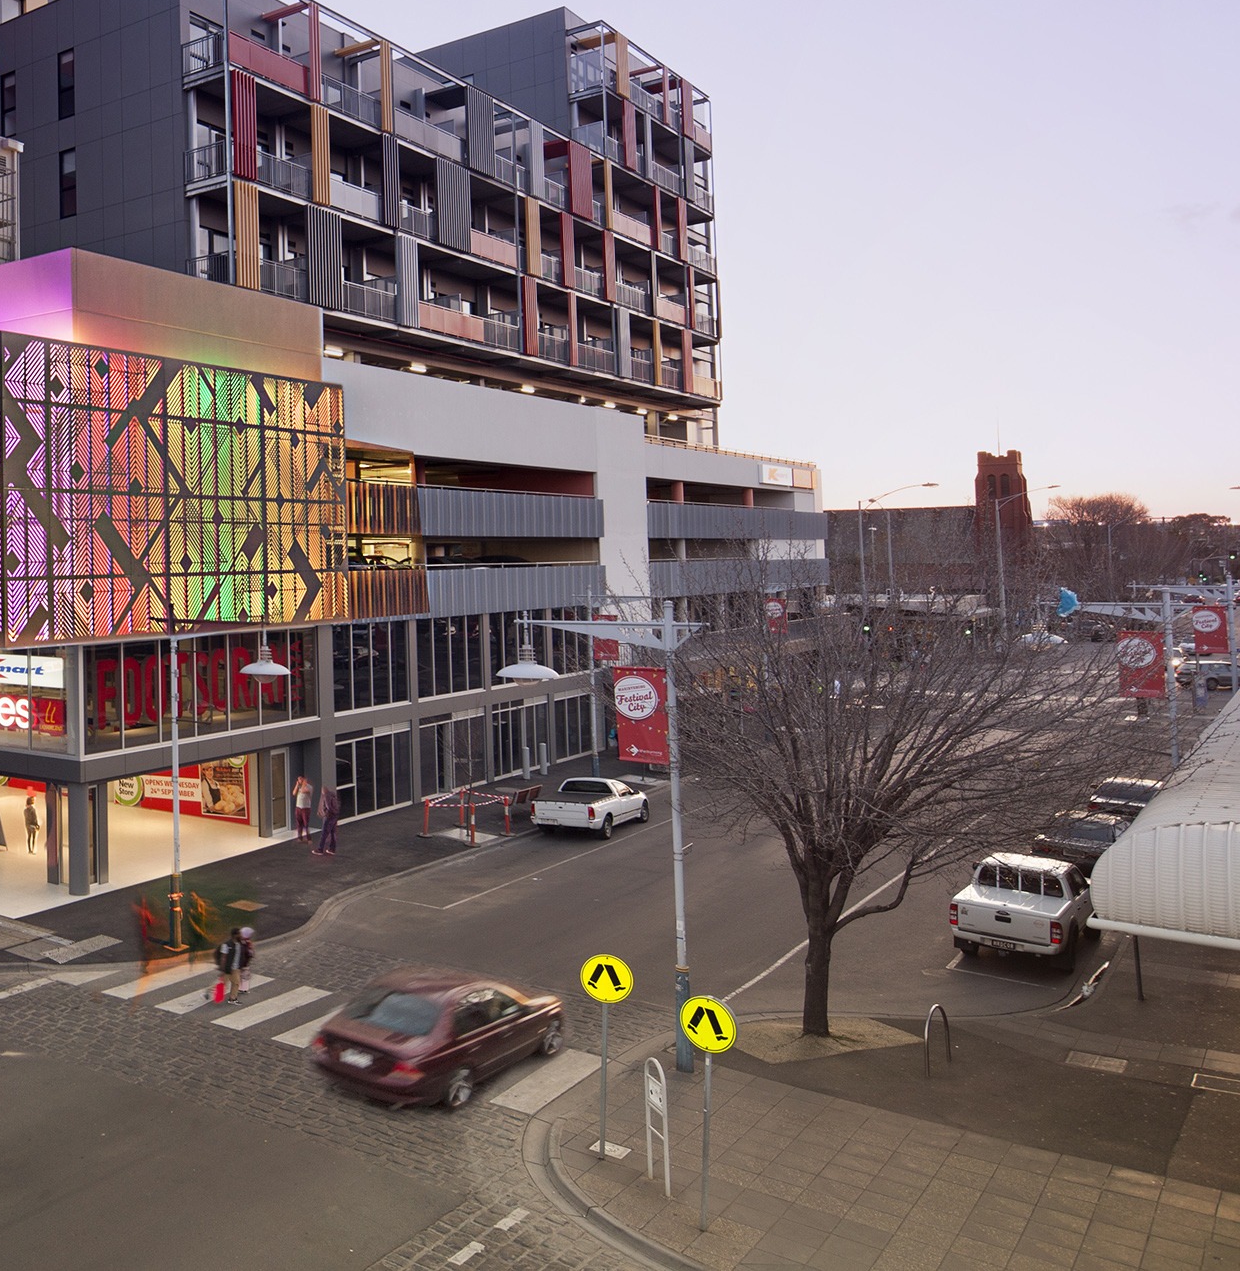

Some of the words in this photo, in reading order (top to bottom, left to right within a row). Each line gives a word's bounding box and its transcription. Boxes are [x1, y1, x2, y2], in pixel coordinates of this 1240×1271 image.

[616, 691, 653, 706] Festival
[627, 702, 646, 712] City
[164, 780, 200, 789] WENESDAY
[119, 787, 135, 797] Store
